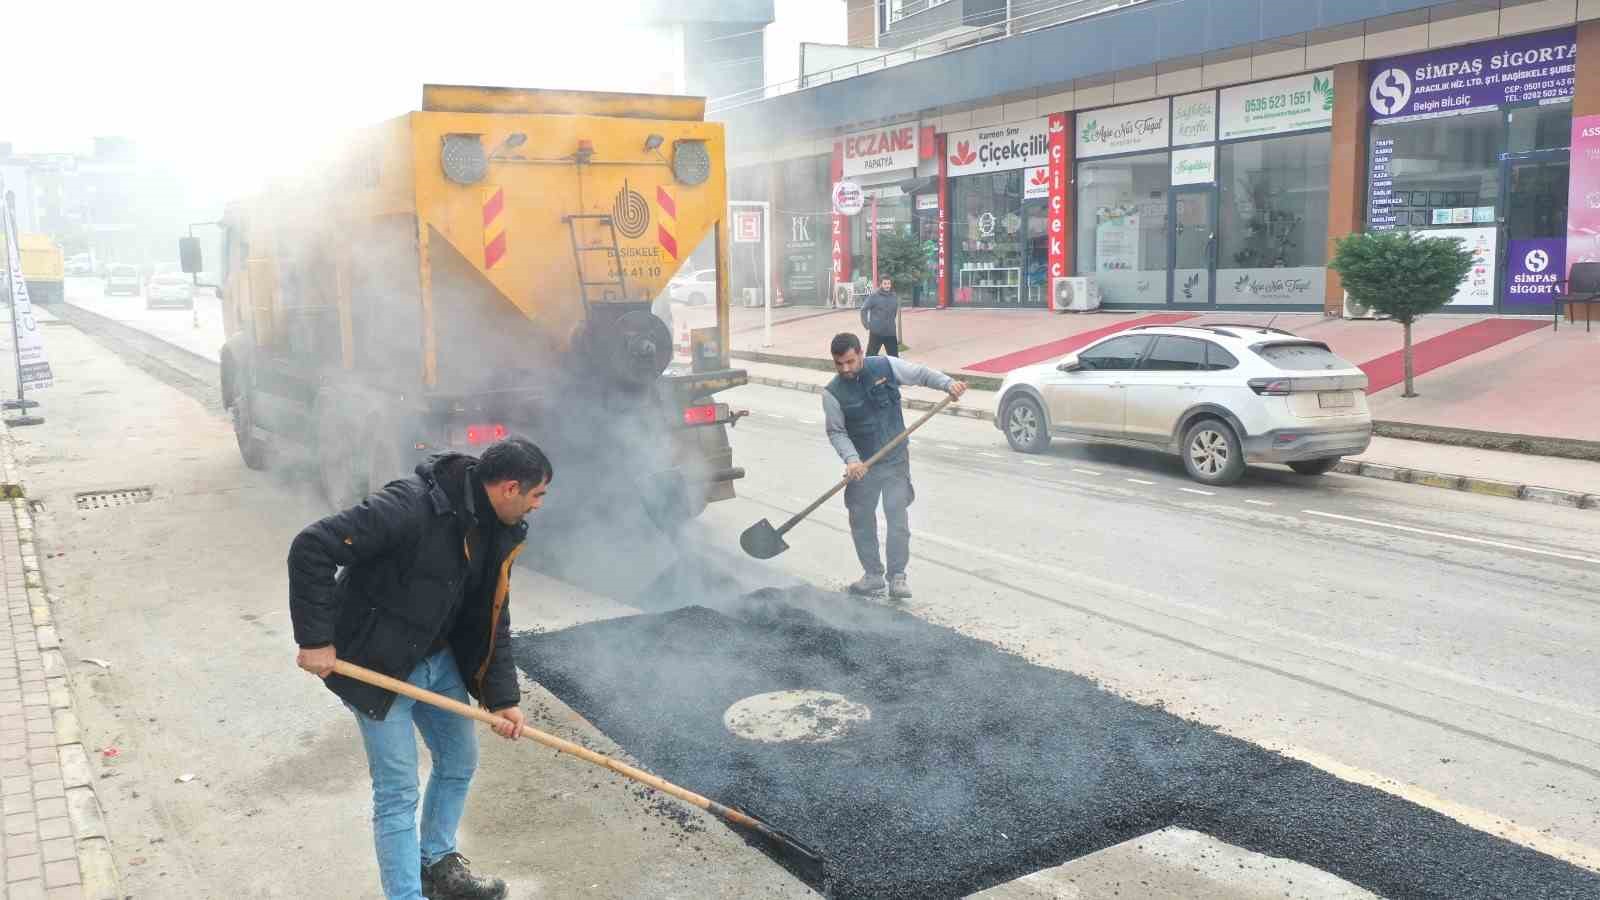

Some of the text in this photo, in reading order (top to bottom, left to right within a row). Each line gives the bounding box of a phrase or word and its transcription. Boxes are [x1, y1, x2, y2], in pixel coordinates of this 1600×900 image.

[1415, 44, 1576, 81] SİMPAŞ SİGORTA
[1413, 100, 1440, 112] Belgin
[845, 127, 914, 160] ECZANE
[979, 134, 1049, 168] Çiçekçilik
[863, 156, 894, 169] PAPATYA
[1510, 283, 1561, 294] SİGORTA
